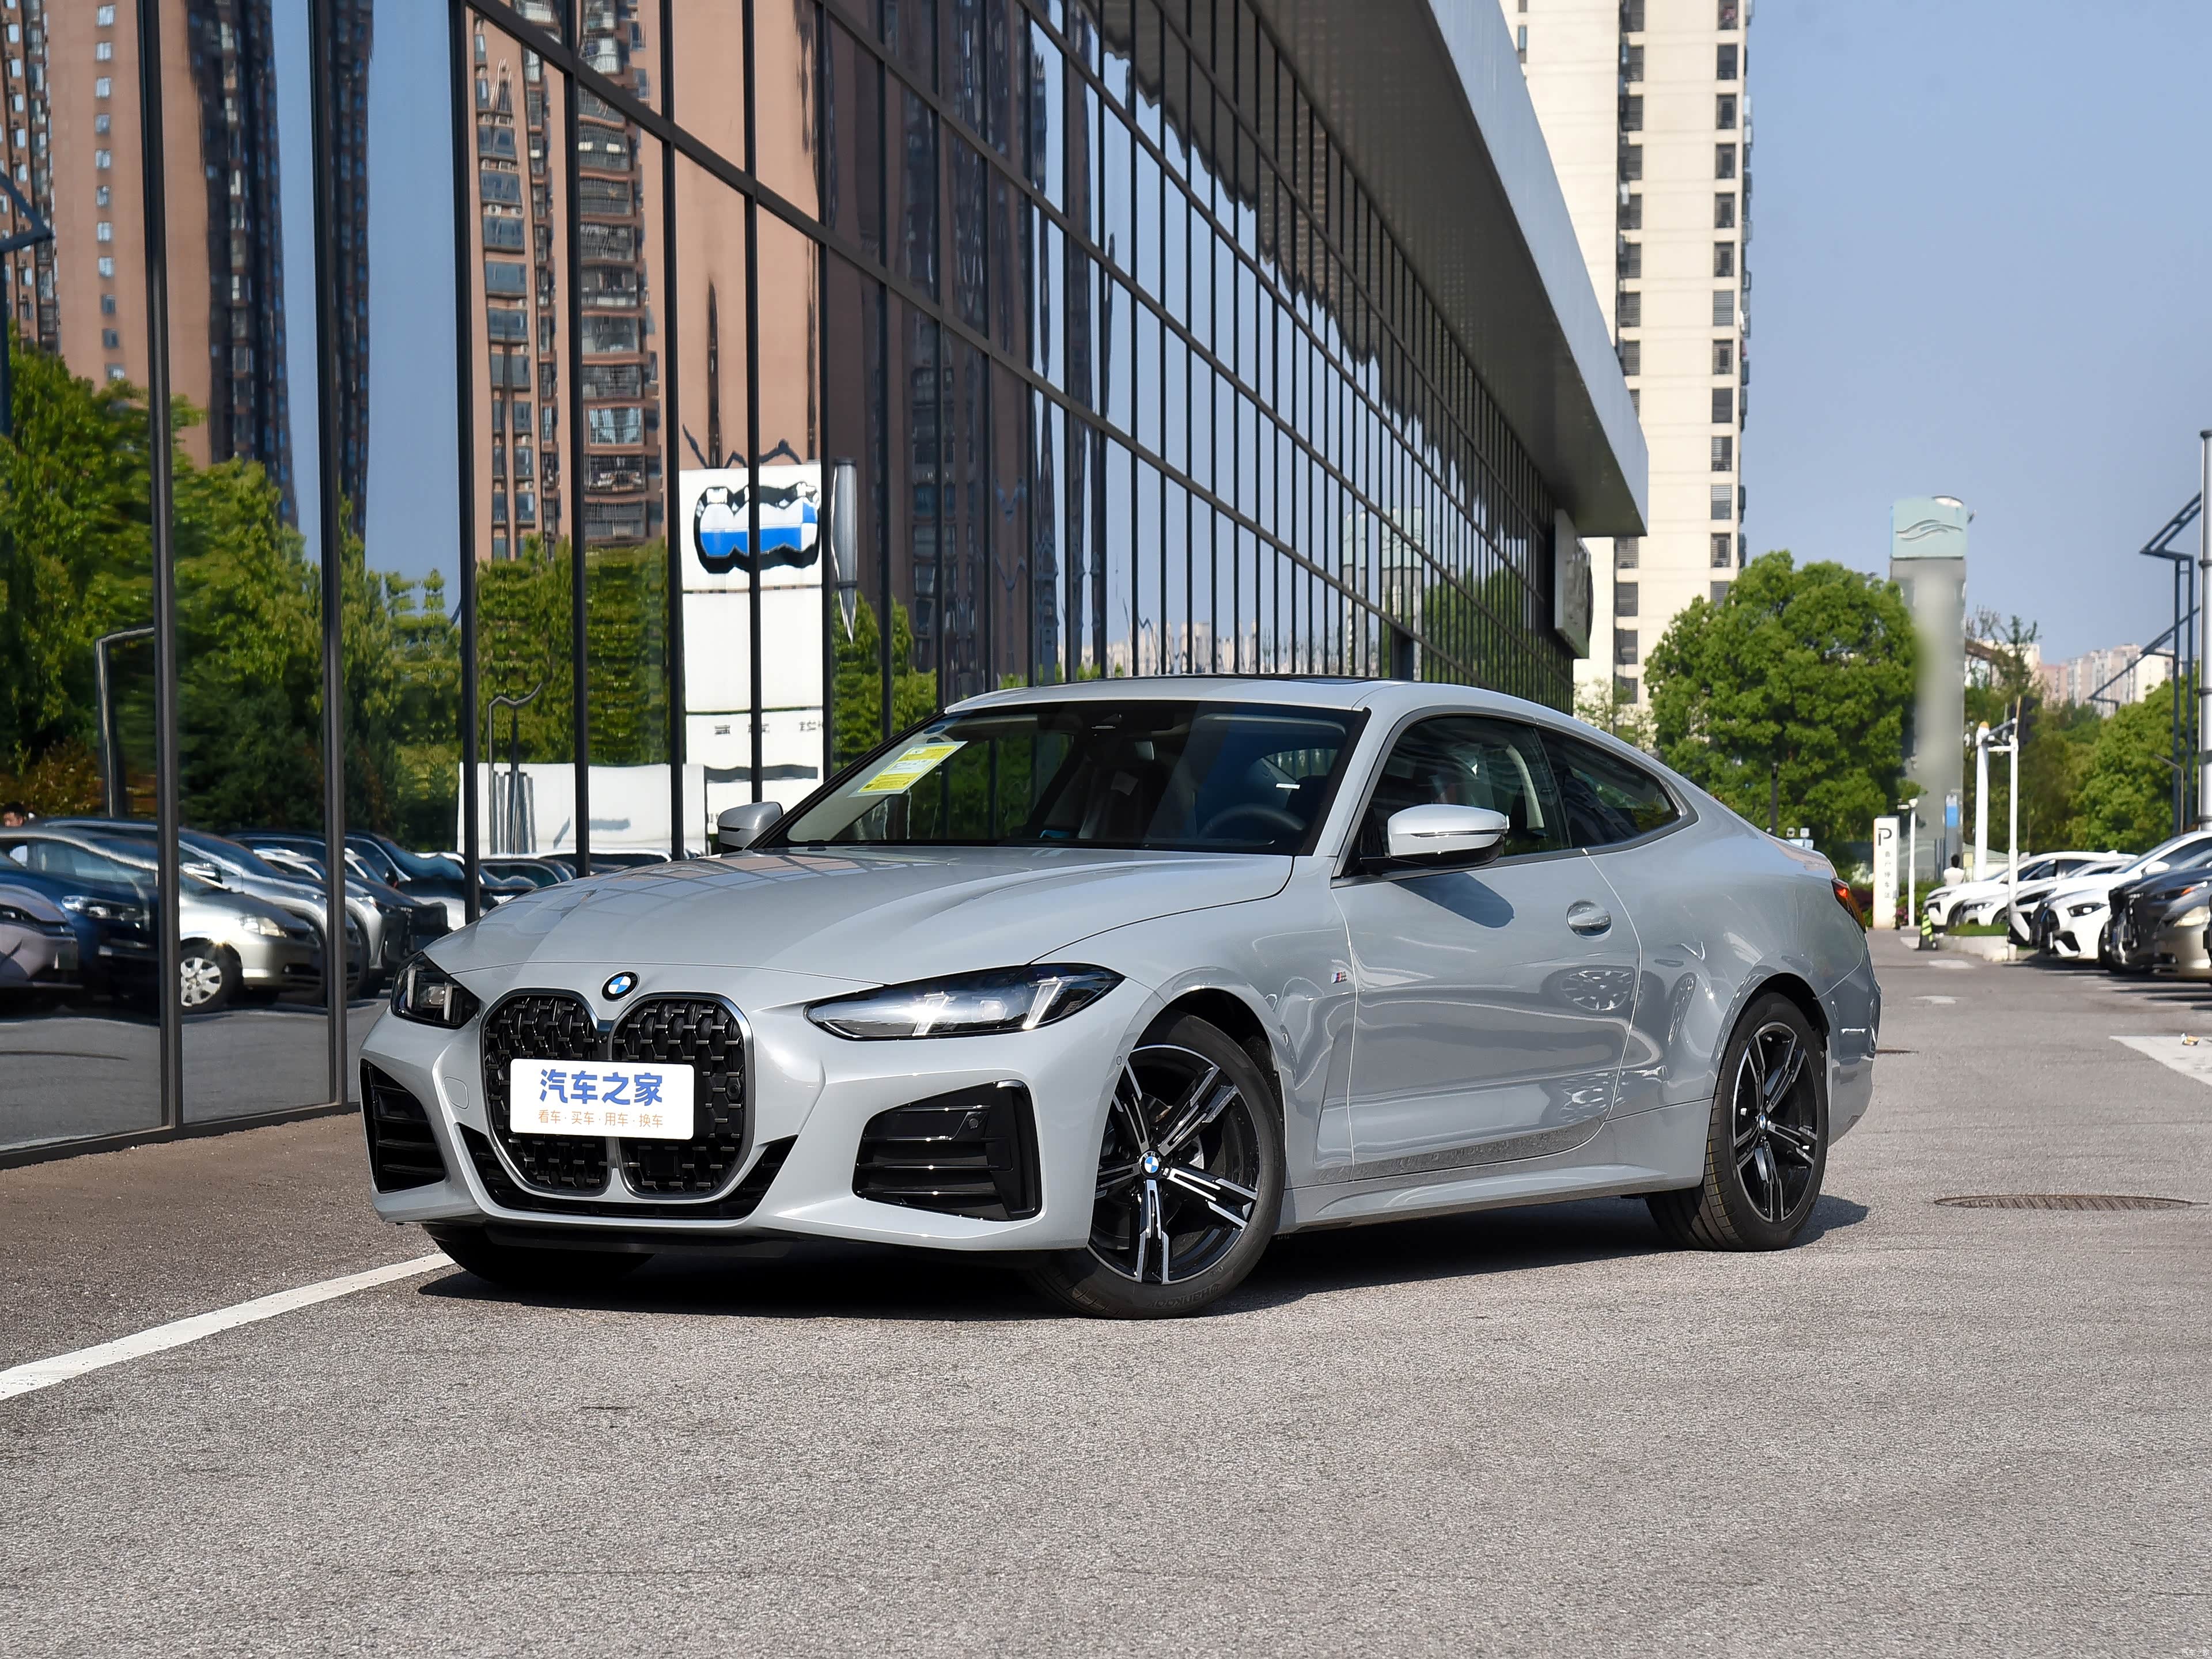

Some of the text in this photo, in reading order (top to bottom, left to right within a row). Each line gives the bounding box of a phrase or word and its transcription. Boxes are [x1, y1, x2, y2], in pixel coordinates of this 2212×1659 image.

[1878, 827, 1892, 846] P
[539, 1069, 662, 1107] 汽车之家
[1143, 1152, 1162, 1162] BMW
